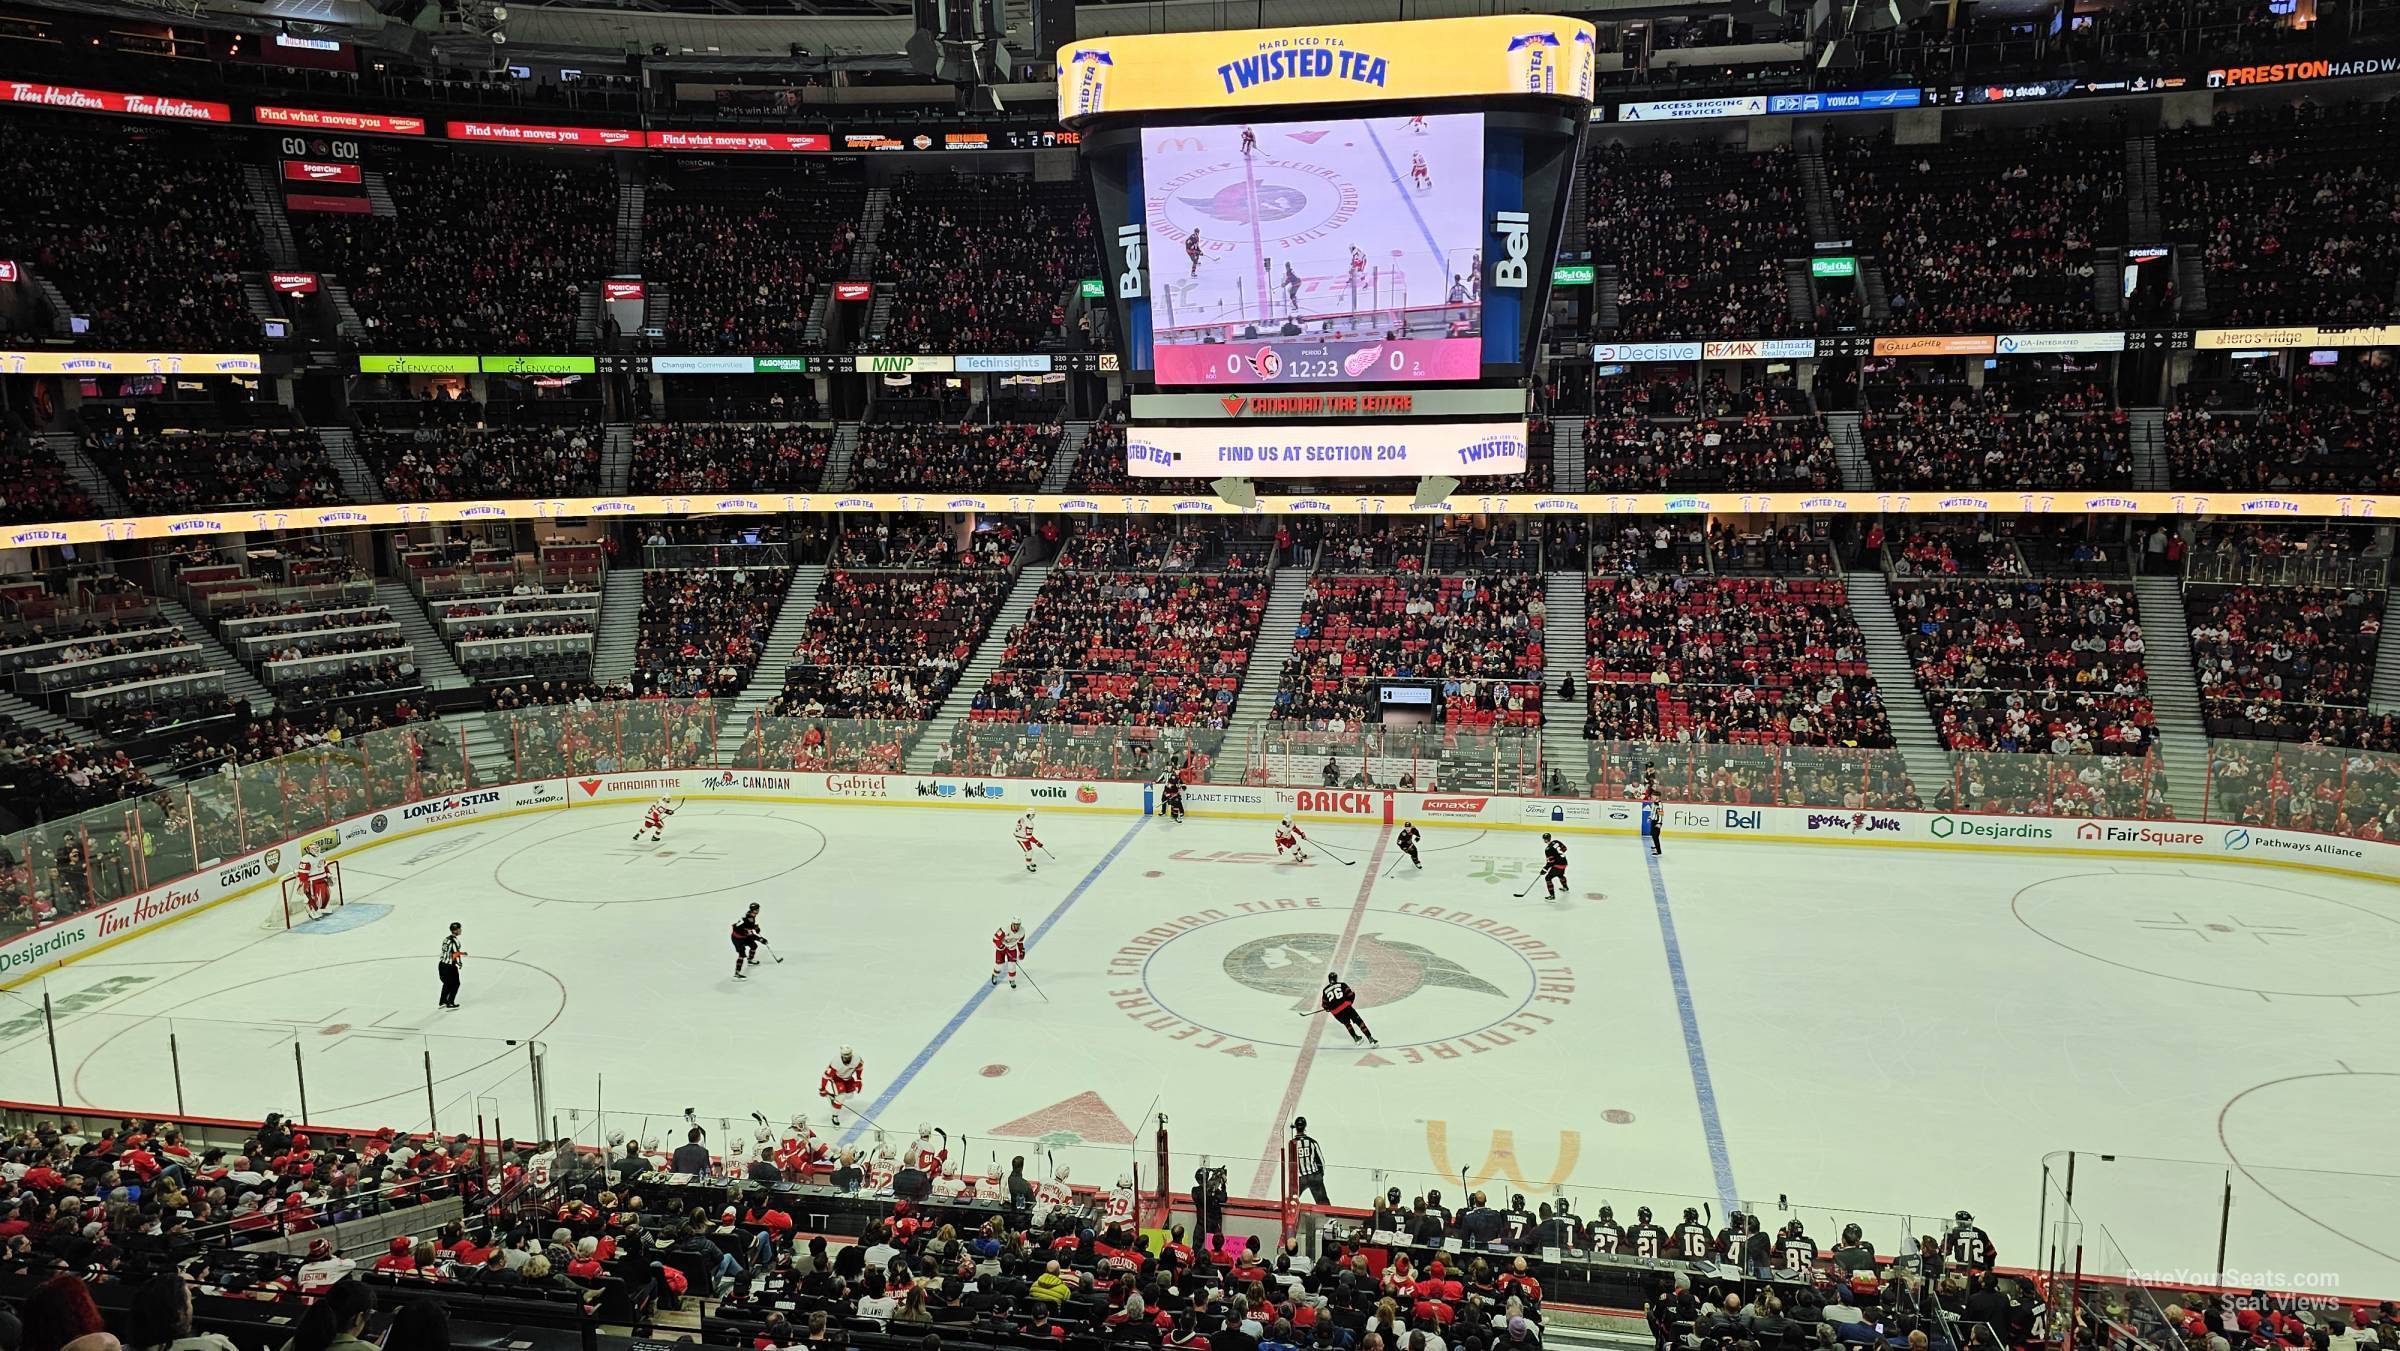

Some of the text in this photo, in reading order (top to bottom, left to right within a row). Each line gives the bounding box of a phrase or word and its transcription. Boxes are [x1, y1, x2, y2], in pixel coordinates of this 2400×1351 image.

[1259, 38, 1344, 49] HARD ICED TEA
[1218, 47, 1388, 94] TWISTED TEA
[2226, 60, 2329, 85] PRESTON
[11, 83, 105, 109] Tim Hortons
[1928, 93, 1937, 103] 4
[1955, 92, 1963, 103] 2
[2016, 86, 2046, 98] skate
[124, 95, 211, 118] Tim Hortons
[1653, 99, 1743, 111] ACCESS RIGGING
[1826, 95, 1859, 107] YOW.CA
[260, 108, 381, 129] Find what moves you
[1672, 108, 1723, 117] SERVICES
[465, 125, 579, 142] Find what moves you
[662, 134, 767, 149] Find what moves you
[1010, 137, 1017, 146] 4
[1032, 137, 1038, 146] 2
[282, 137, 359, 159] GO GO!
[1495, 210, 1530, 289] Bell
[1119, 223, 1141, 300] Bell
[2129, 332, 2147, 340] 324
[1322, 346, 1328, 356] 1
[1619, 345, 1697, 361] Decisive
[1706, 340, 1813, 357] RE/MAX Hallmark
[1761, 347, 1813, 358] Realty Group
[1886, 341, 1942, 353] GALLAGHER
[61, 359, 113, 371] TWISTED TEA
[215, 360, 249, 370] TWISTED
[661, 361, 696, 370] Changing
[872, 357, 914, 371] MNP
[965, 357, 1040, 371] TechInsights
[1209, 365, 1216, 374] 4
[1227, 350, 1404, 378] 0 12:23 0
[1413, 361, 1420, 371] 2
[1250, 395, 1413, 414] CANADIAN TIRE CENTRE
[1148, 446, 1172, 466] TEA
[1218, 445, 1407, 462] FIND US AT SECTION 204
[1458, 440, 1515, 465] TWISTED
[459, 506, 506, 517] TWISTED TEA
[834, 498, 874, 509] TWISTED TEA
[1172, 499, 1213, 511] TWISTED TEA
[1664, 500, 1711, 511] TWISTED TEA
[2085, 498, 2138, 511] TWISTED TEA
[11, 530, 68, 544] TWISTED TEA
[607, 778, 681, 791] CANADIAN TIRE
[742, 776, 791, 790] CANADIAN
[826, 774, 887, 792] Gabriel
[1031, 785, 1067, 798] voilà
[845, 789, 888, 797] PIZZA
[1186, 792, 1262, 804] PLANET FITNESS
[1275, 790, 1373, 813] The BRICK
[403, 791, 500, 819] LONE STAR
[425, 808, 479, 825] TEXAS GRILL
[1674, 810, 1761, 829] Fibe Bell
[1807, 814, 1901, 831] Booster Juice
[1960, 821, 2053, 839] Desjardins
[2107, 827, 2204, 846] FairSquare
[2255, 836, 2363, 859] Pathways Alliance
[221, 864, 260, 887] CASINO
[94, 888, 200, 938] Tim Hortons
[1234, 896, 1323, 914] TIRE
[1398, 902, 1562, 962] CANADIAN
[0, 928, 86, 973] Desjardins
[1106, 908, 1230, 977] CANADIAN
[1534, 966, 1576, 1006] TIRE
[1107, 986, 1228, 1050] CENTRE
[1397, 1011, 1556, 1065] CENTRE
[1298, 1147, 1311, 1158] 90
[1510, 1222, 1523, 1240] 7
[1594, 1233, 1619, 1255] 27
[1637, 1237, 1658, 1259] 21
[1683, 1233, 1706, 1257] 16
[1957, 1237, 1985, 1264] 72
[1786, 1247, 1813, 1272] 85
